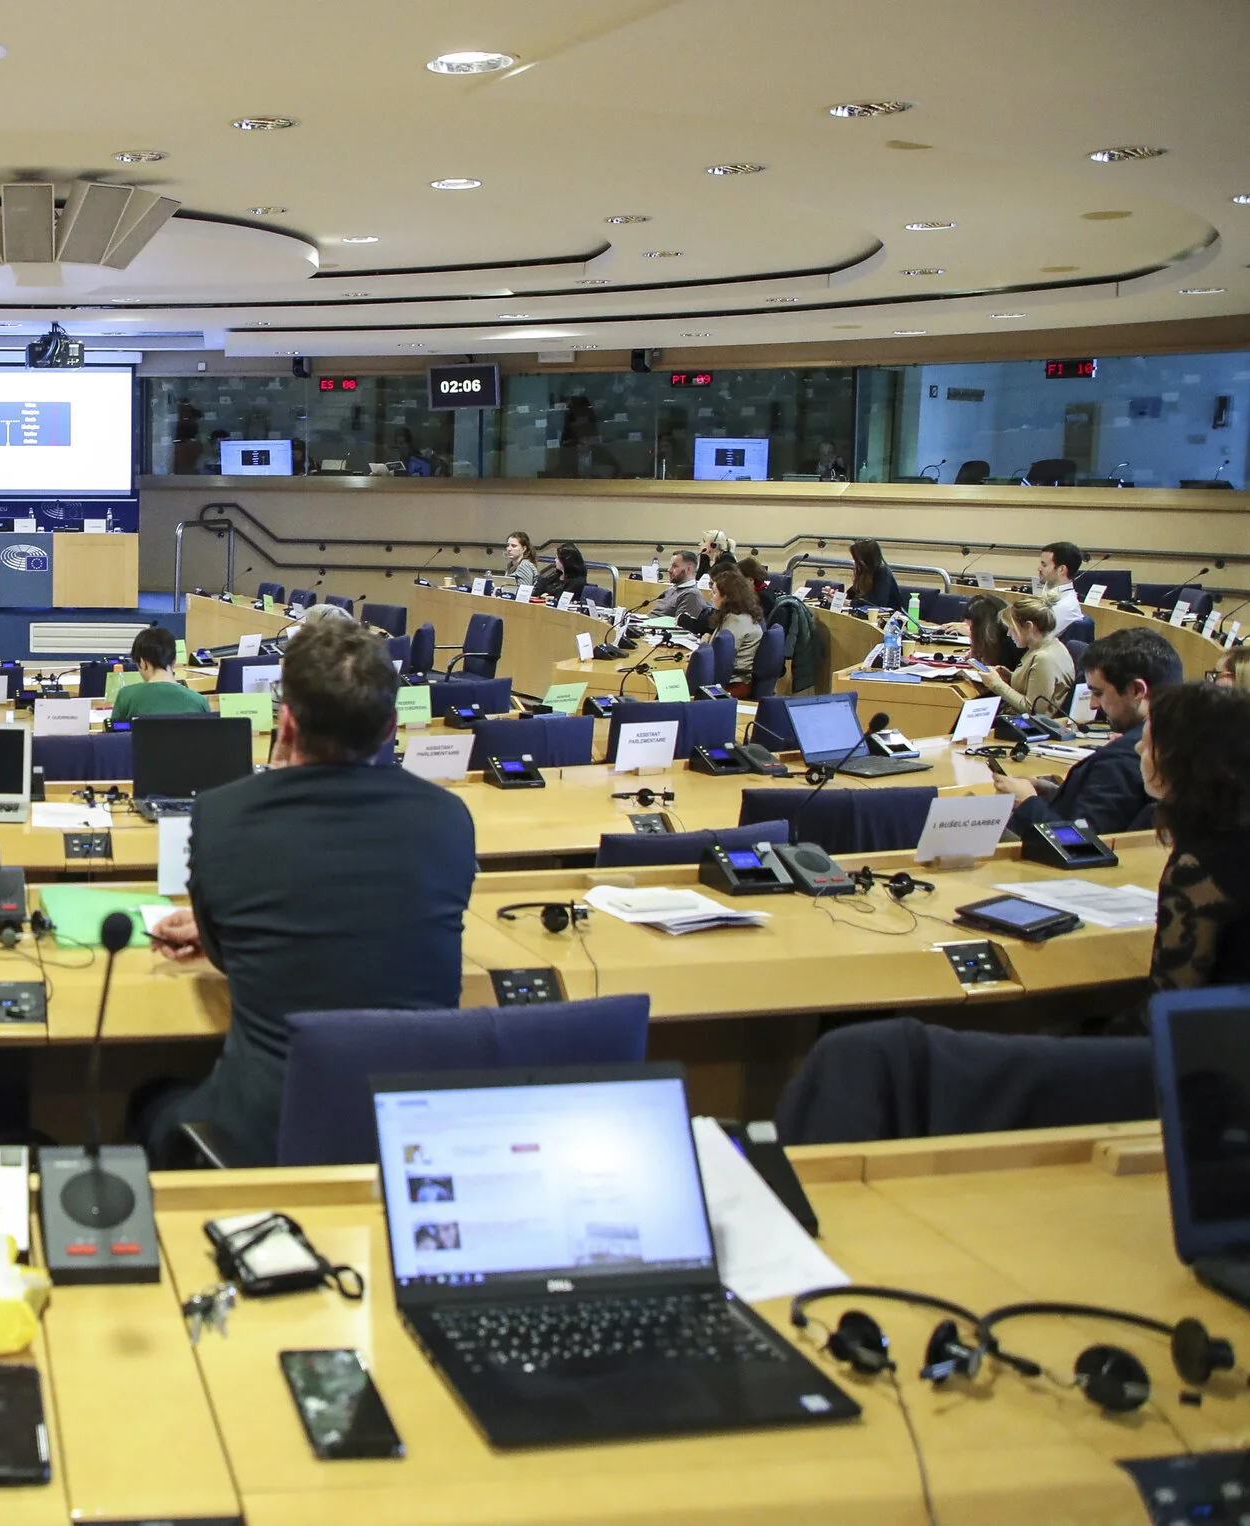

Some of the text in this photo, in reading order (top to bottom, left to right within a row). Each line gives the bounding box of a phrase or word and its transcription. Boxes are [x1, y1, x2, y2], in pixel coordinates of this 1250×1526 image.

[1047, 362, 1093, 375] FI 10
[321, 380, 334, 389] ES
[672, 374, 686, 385] PT
[440, 379, 481, 393] 02:06
[971, 818, 1001, 827] GARBER
[547, 1278, 575, 1292] DELL
